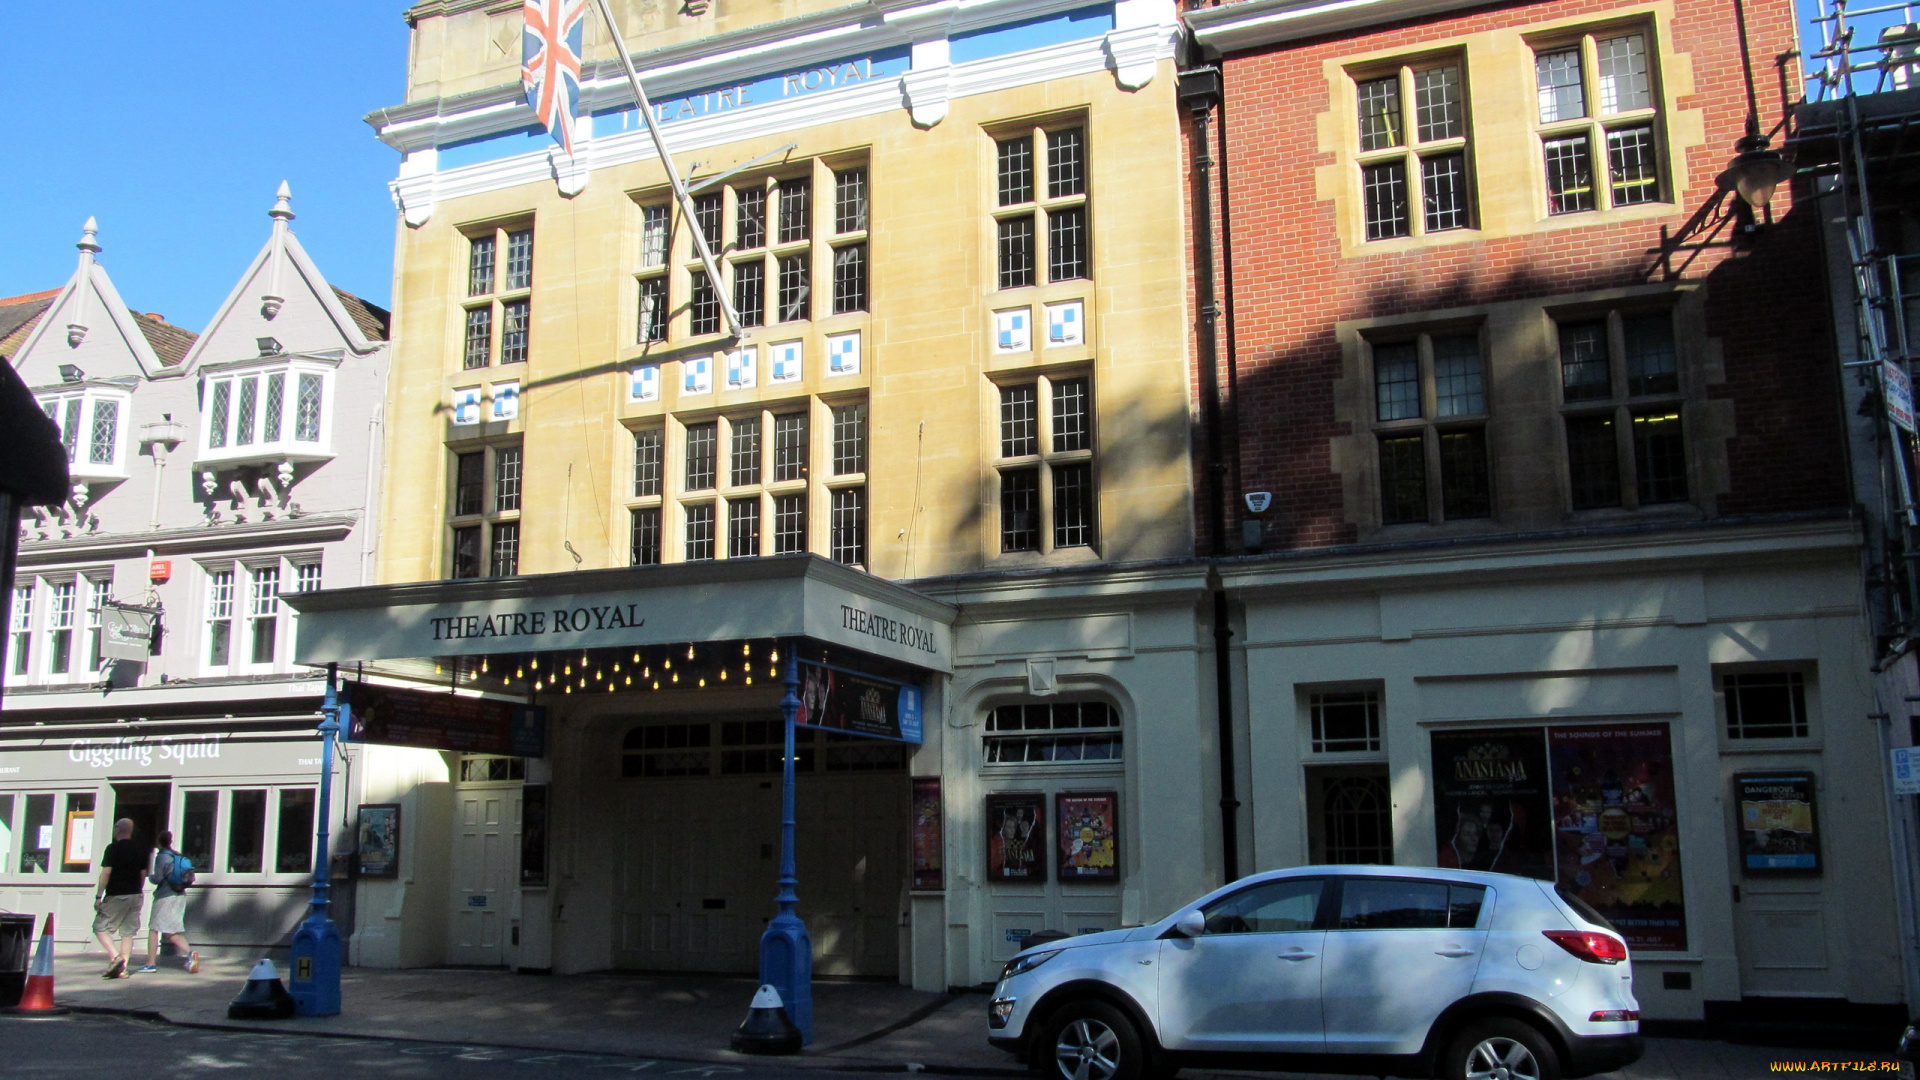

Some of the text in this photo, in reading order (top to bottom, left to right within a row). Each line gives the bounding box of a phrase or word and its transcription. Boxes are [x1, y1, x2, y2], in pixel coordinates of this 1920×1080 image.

[617, 57, 885, 130] THEATRE ROYAL
[430, 603, 645, 641] THEATRE ROYAL
[841, 604, 937, 654] THEATRE ROYAL
[288, 683, 305, 693] Thai
[1569, 731, 1600, 739] SOUNDS
[1629, 729, 1662, 737] SUMMER
[69, 733, 221, 768] Giggling Squid
[298, 758, 314, 766] THAI
[1454, 759, 1526, 778] ANASTASIA
[1744, 785, 1795, 794] DANGEROUS
[1627, 919, 1648, 927] BETTER
[299, 959, 311, 977] H
